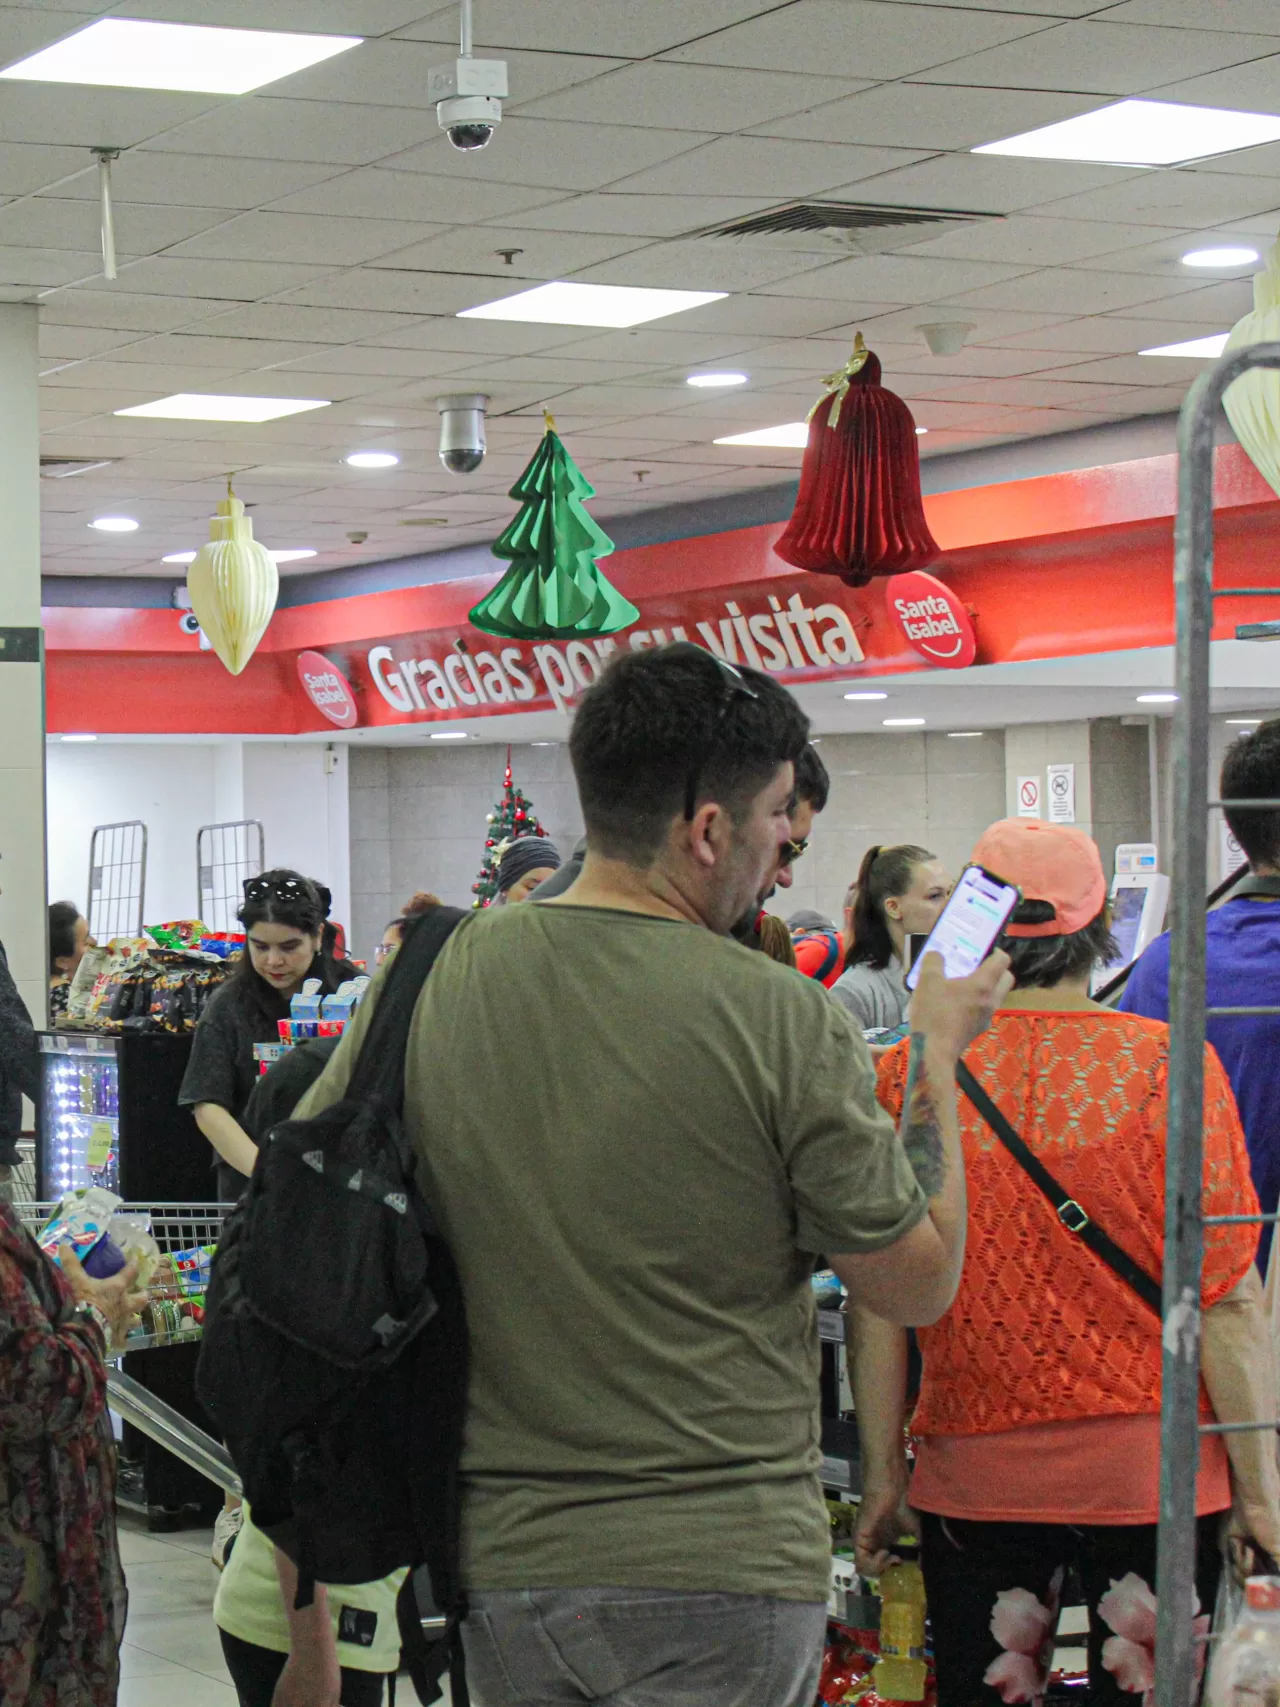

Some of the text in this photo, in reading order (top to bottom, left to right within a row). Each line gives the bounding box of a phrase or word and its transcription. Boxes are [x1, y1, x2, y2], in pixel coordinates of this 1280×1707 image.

[893, 595, 951, 620] Santa
[367, 637, 537, 712] Gracias
[696, 592, 866, 671] visita
[304, 672, 338, 689] Santa
[311, 686, 348, 704] Isabel
